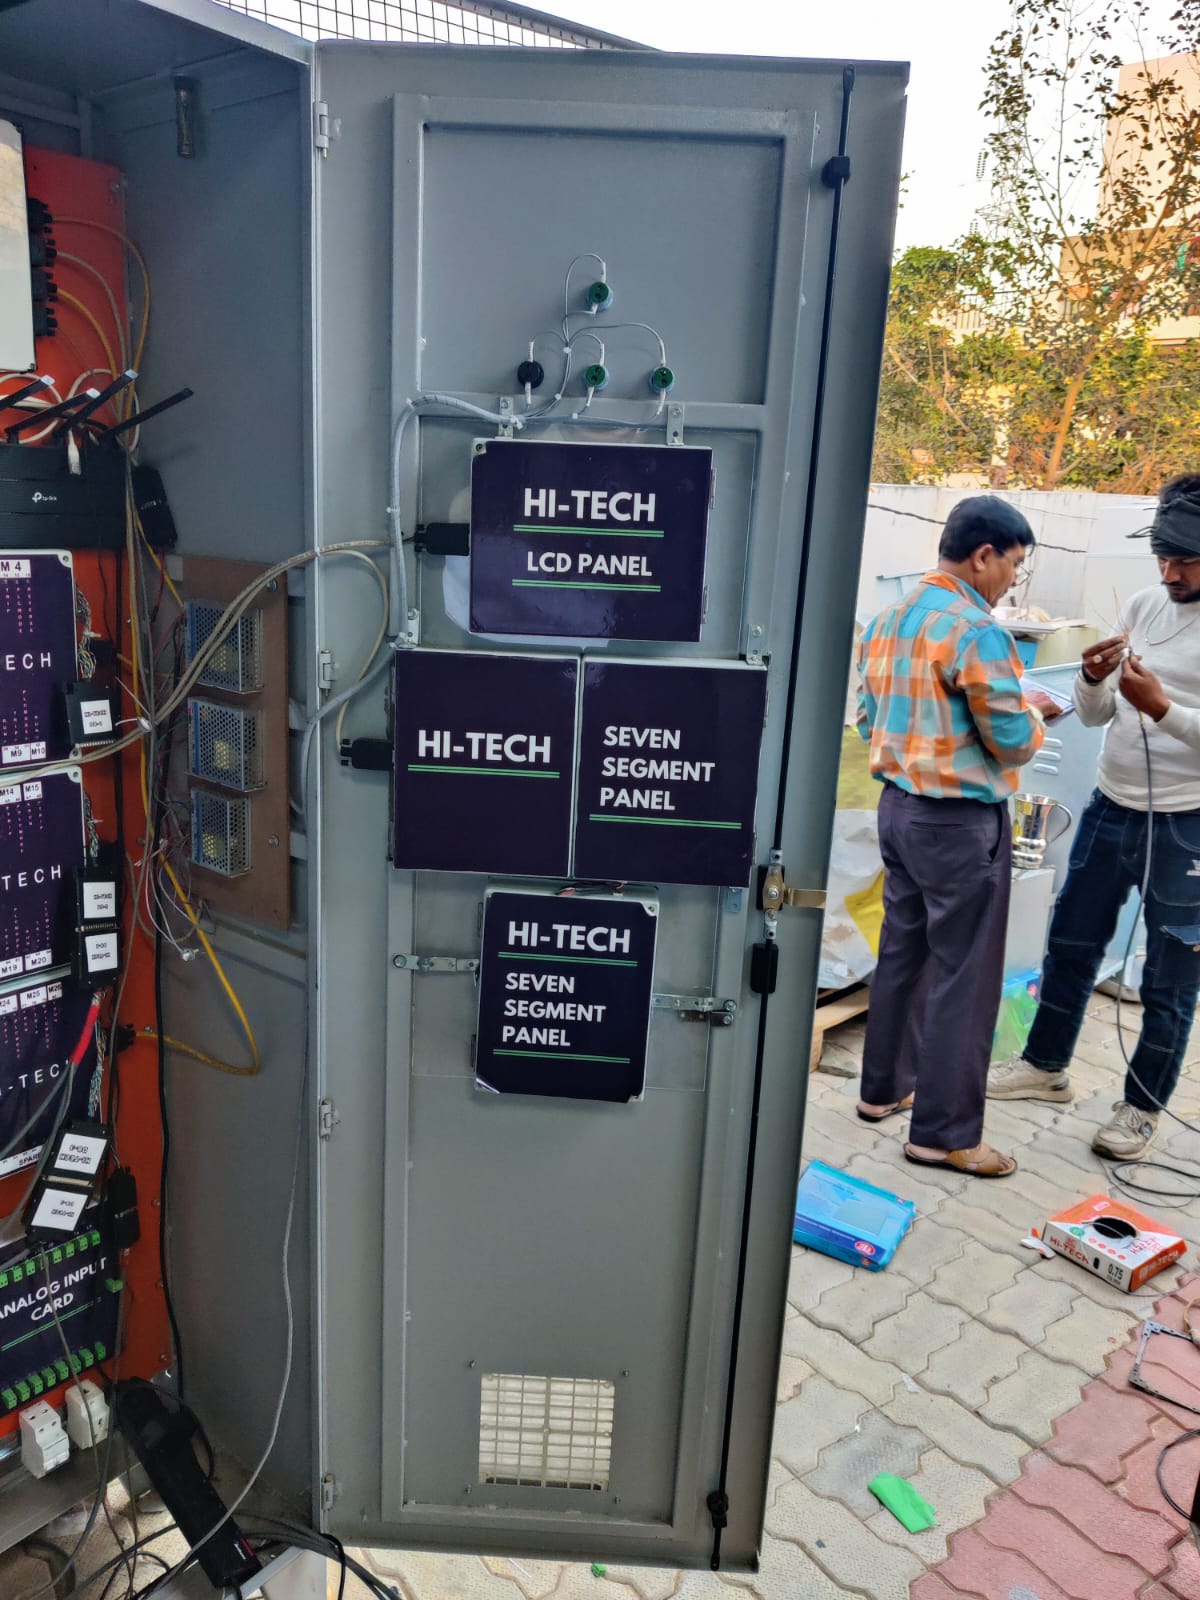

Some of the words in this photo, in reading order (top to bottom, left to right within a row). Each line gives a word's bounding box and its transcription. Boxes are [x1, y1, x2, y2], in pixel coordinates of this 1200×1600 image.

[523, 487, 656, 522] HI-TECH
[14, 561, 22, 572] 4
[527, 551, 572, 573] LCD
[578, 553, 653, 577] PANEL
[417, 729, 551, 764] HI-TECH
[602, 725, 681, 750] SEVEN
[600, 757, 715, 783] SEGMENT
[599, 786, 676, 812] PANEL
[508, 920, 631, 954] HI-TECH
[31, 956, 47, 966] M20
[504, 972, 576, 994] SEVEN
[503, 999, 607, 1023] SEGMENT
[501, 1025, 571, 1047] PANEL
[63, 1257, 107, 1288] INPUT
[1107, 1263, 1124, 1281] 0.75
[30, 1292, 74, 1322] CARD
